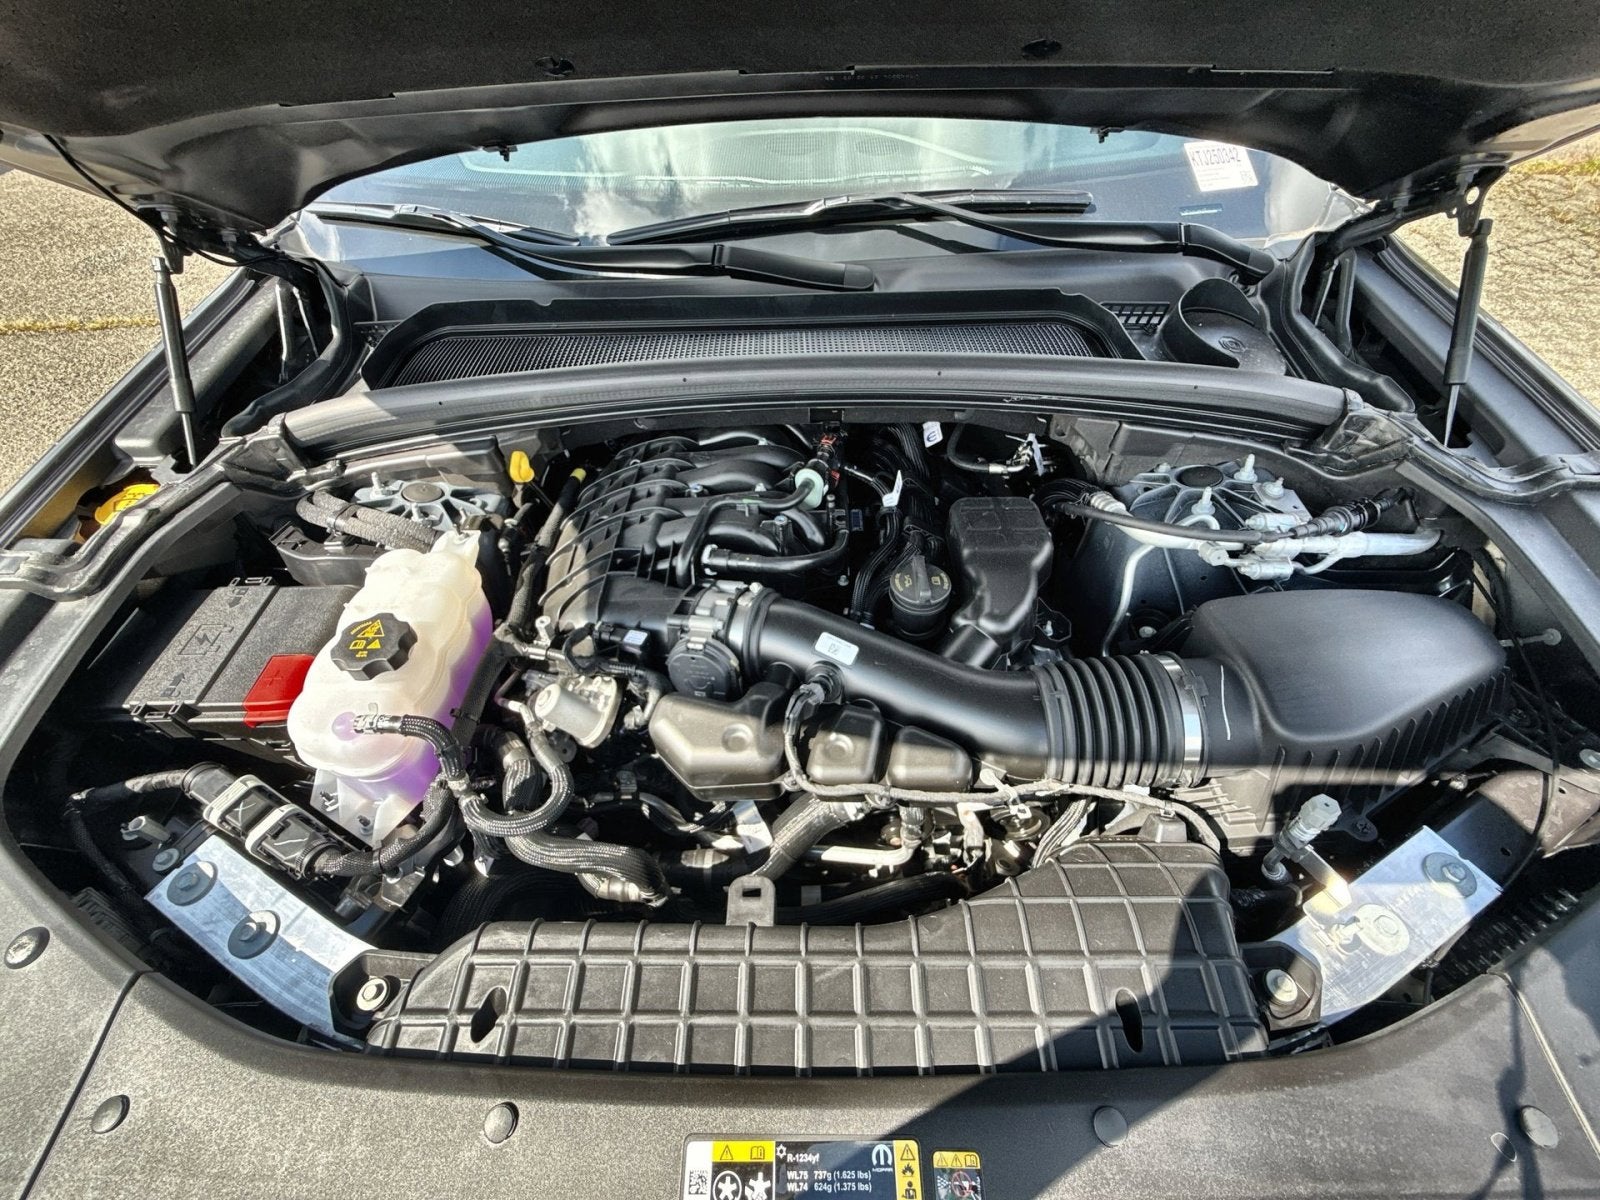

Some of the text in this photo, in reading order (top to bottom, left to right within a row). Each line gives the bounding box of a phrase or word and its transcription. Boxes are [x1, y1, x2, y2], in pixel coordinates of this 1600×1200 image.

[787, 1153, 820, 1164] R-1234yf
[787, 1170, 872, 1181] WL75 737g (1.625 lbs)
[787, 1182, 873, 1193] WL74 624g (1.375 lbs)
